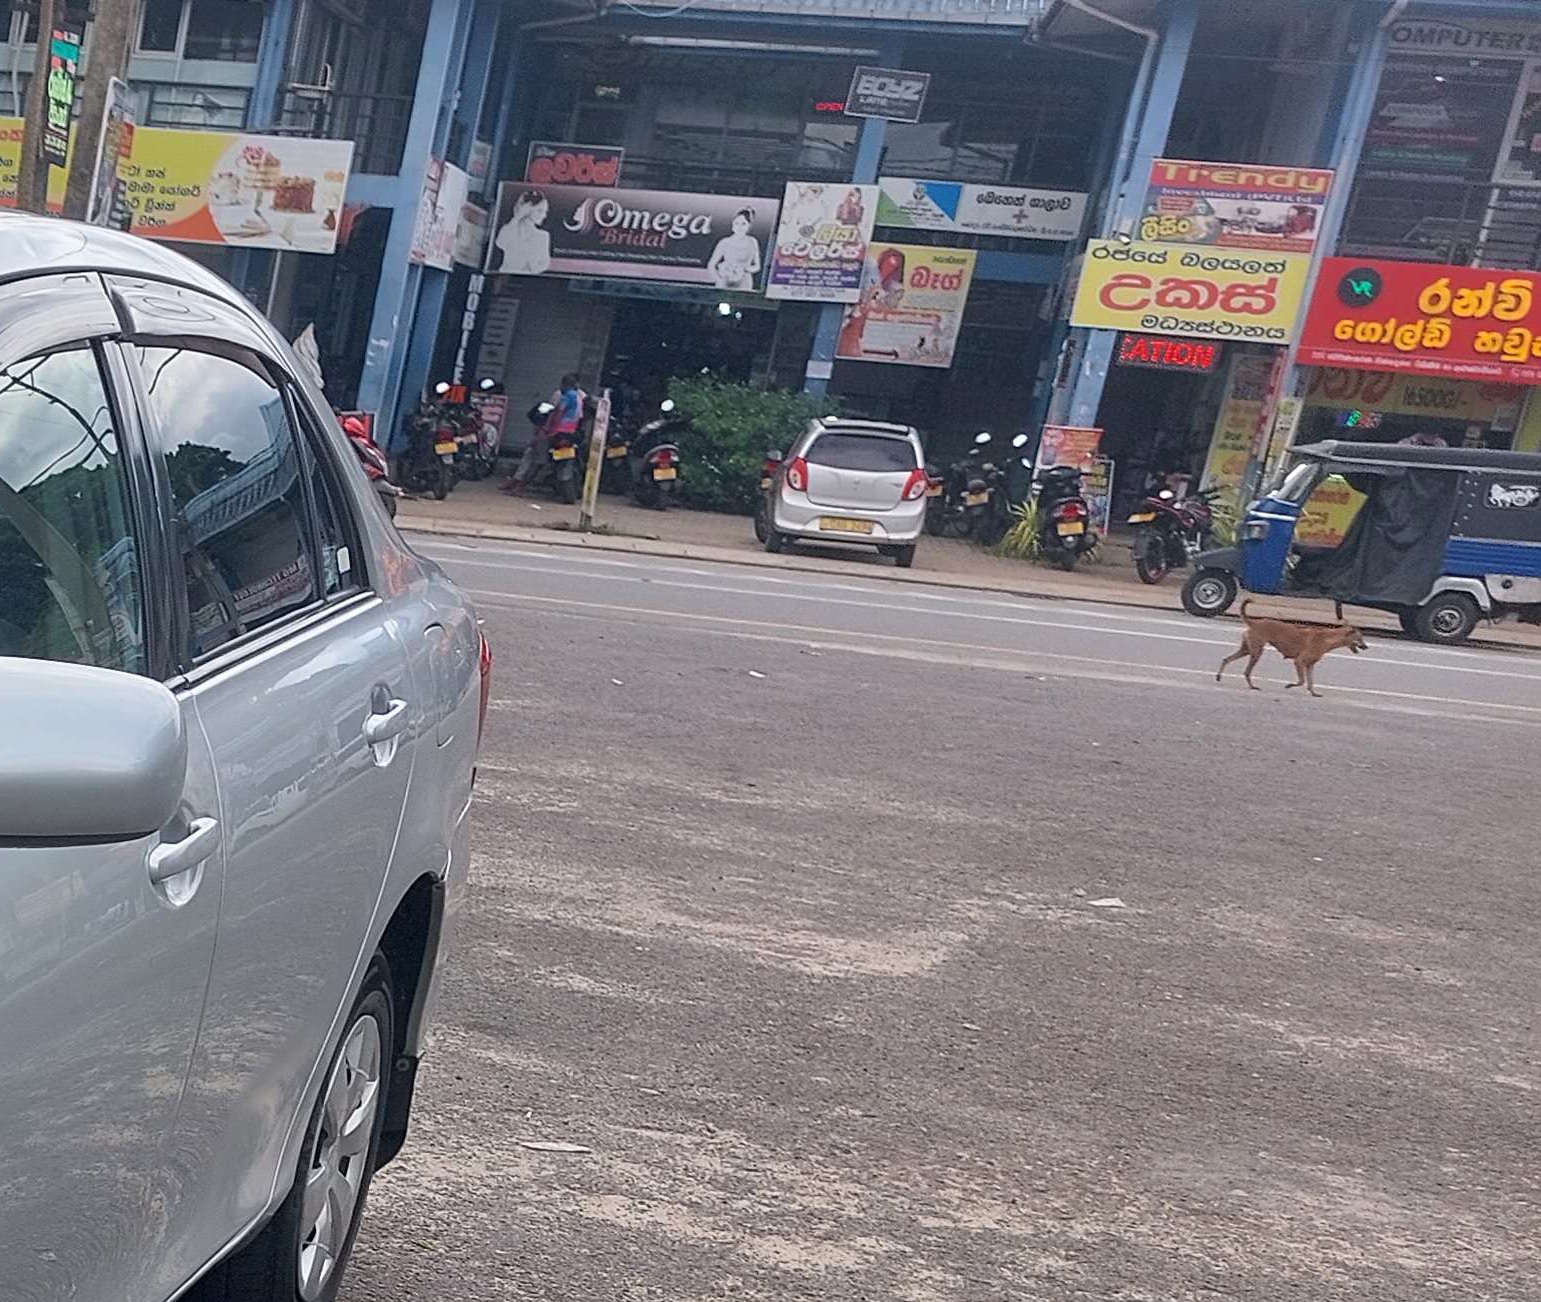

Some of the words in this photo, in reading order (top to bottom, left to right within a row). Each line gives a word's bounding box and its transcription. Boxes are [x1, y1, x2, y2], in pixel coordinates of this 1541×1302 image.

[1157, 162, 1326, 194] Trendy
[594, 198, 713, 240] Omega
[599, 229, 667, 249] Bridal
[1092, 245, 1168, 265] රජයේ
[1180, 252, 1287, 274] බලයලත්
[1099, 273, 1279, 316] උකස්
[452, 273, 485, 385] MOBILE
[1141, 315, 1286, 340] මධ්‍යස්ථානය
